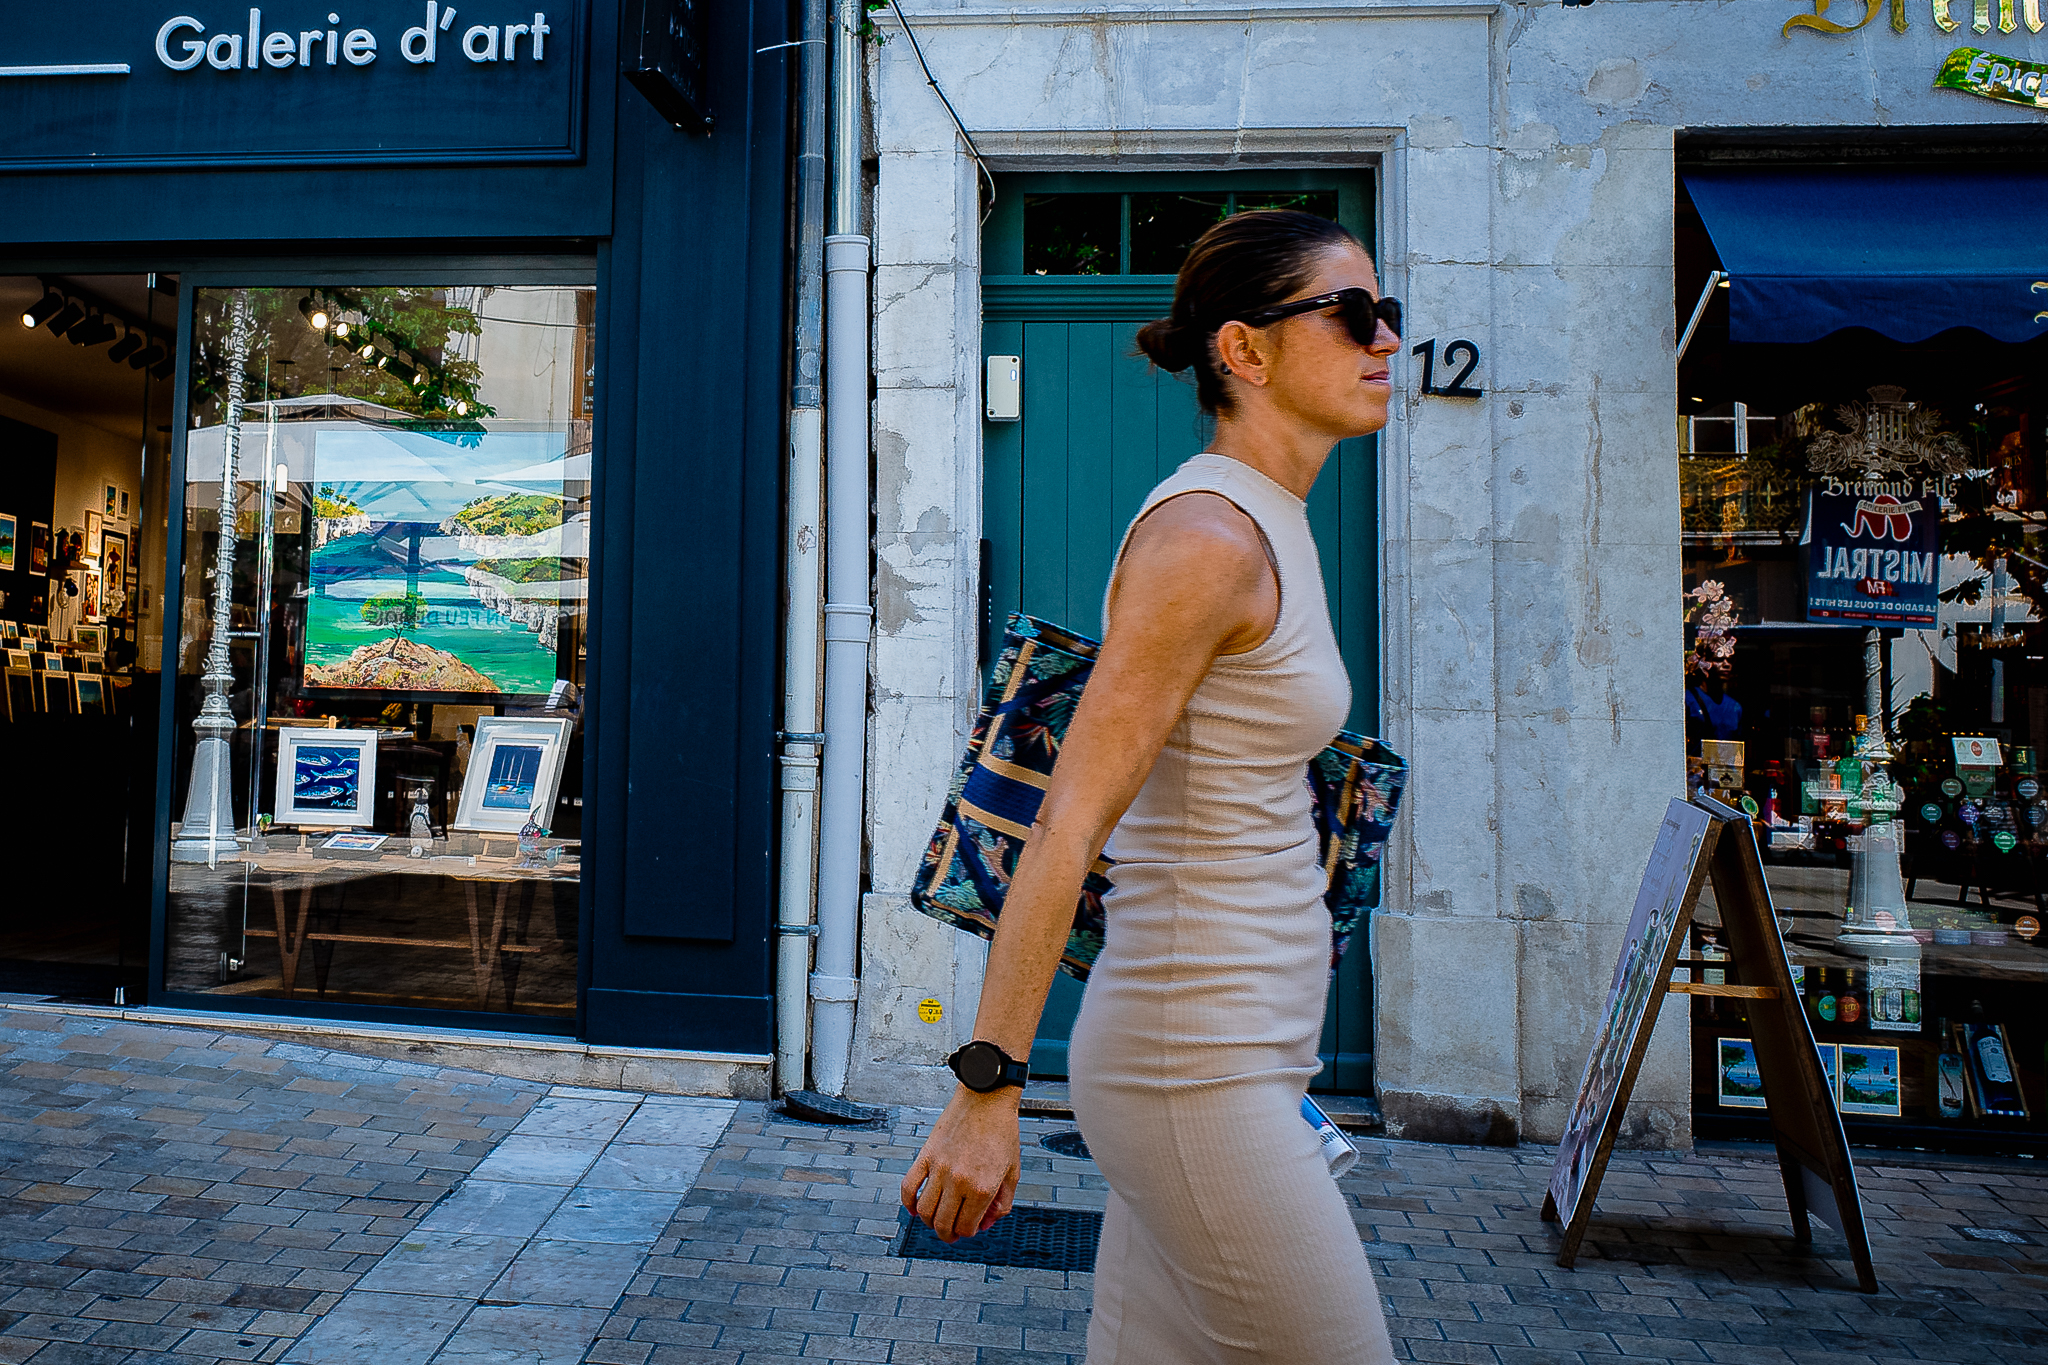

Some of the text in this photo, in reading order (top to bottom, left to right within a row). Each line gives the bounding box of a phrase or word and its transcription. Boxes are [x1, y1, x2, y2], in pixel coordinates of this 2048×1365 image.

[155, 0, 551, 71] Galerie d'art
[1411, 337, 1483, 397] 12
[1921, 476, 1958, 499] Fils
